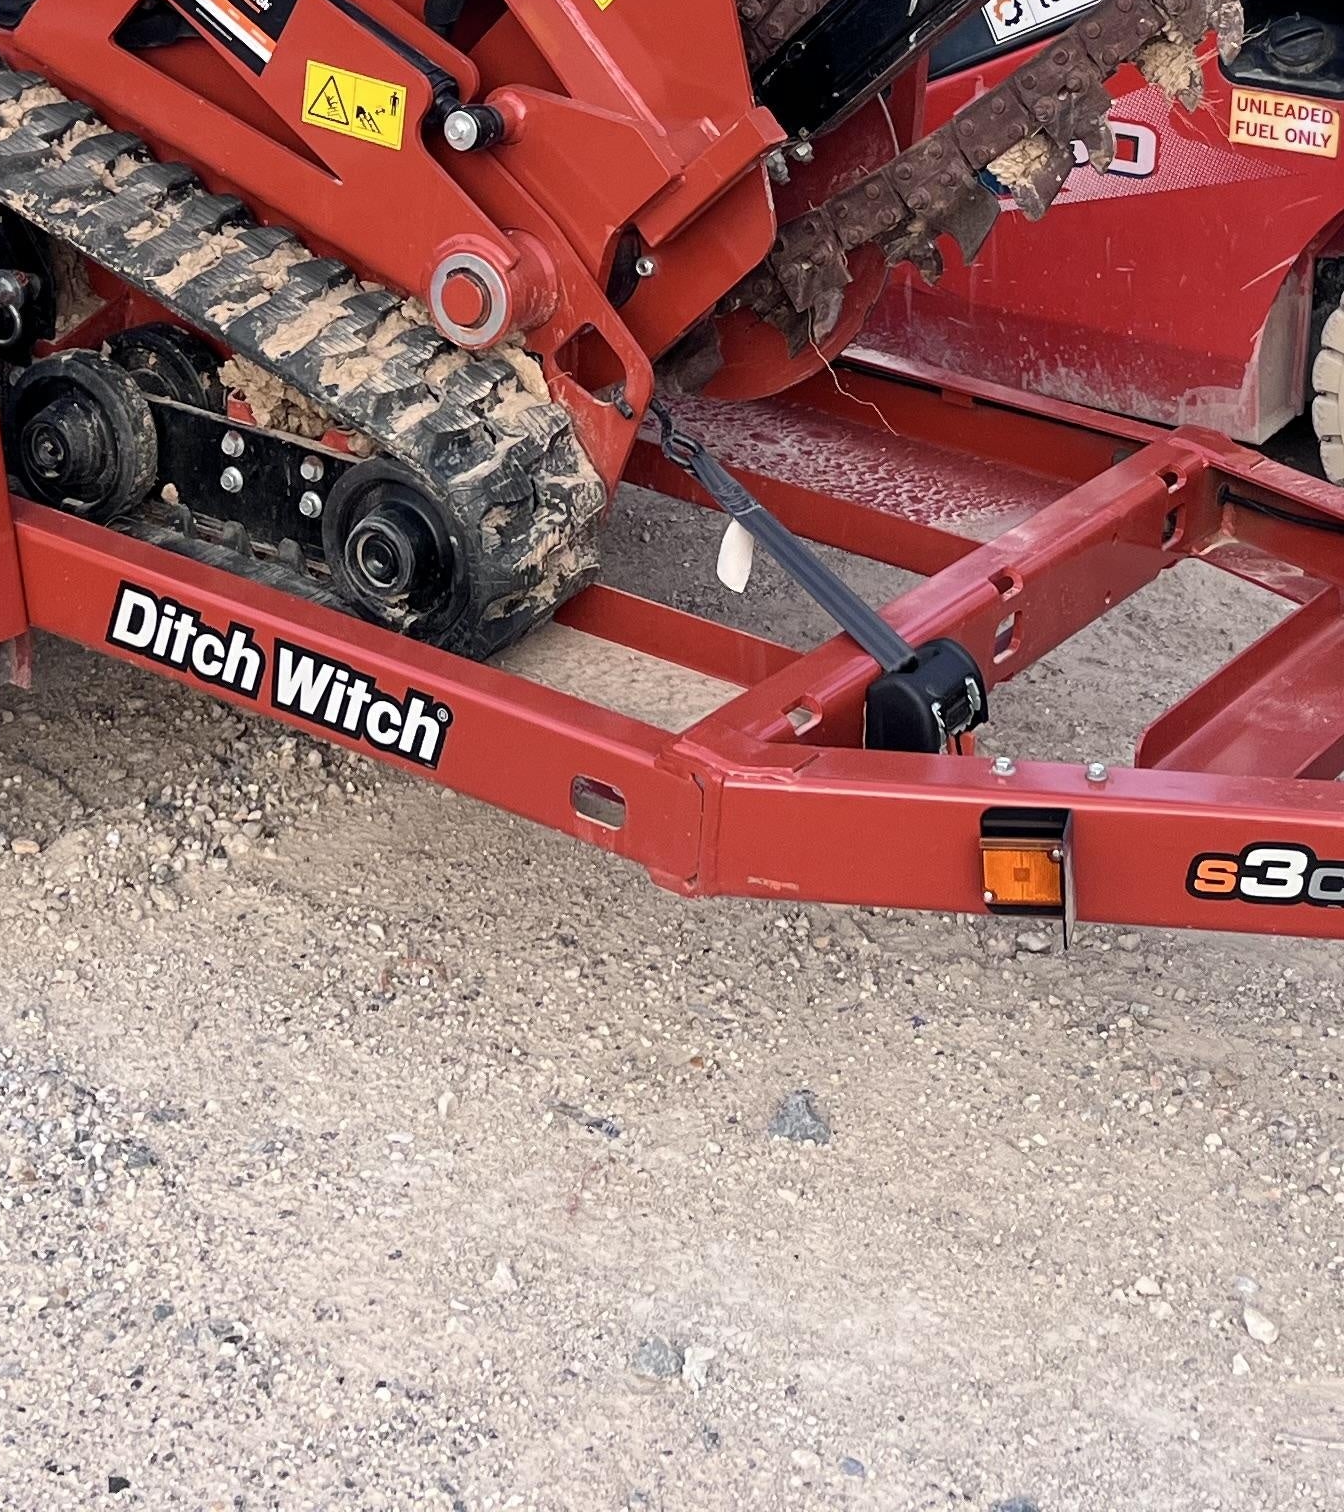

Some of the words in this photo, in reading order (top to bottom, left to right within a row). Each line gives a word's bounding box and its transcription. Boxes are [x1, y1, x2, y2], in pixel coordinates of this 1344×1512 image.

[1236, 96, 1334, 125] UNLEADED
[1235, 120, 1280, 141] FUEL
[1285, 128, 1332, 149] ONLY
[112, 588, 262, 692] Ditch
[276, 646, 442, 762] Witch
